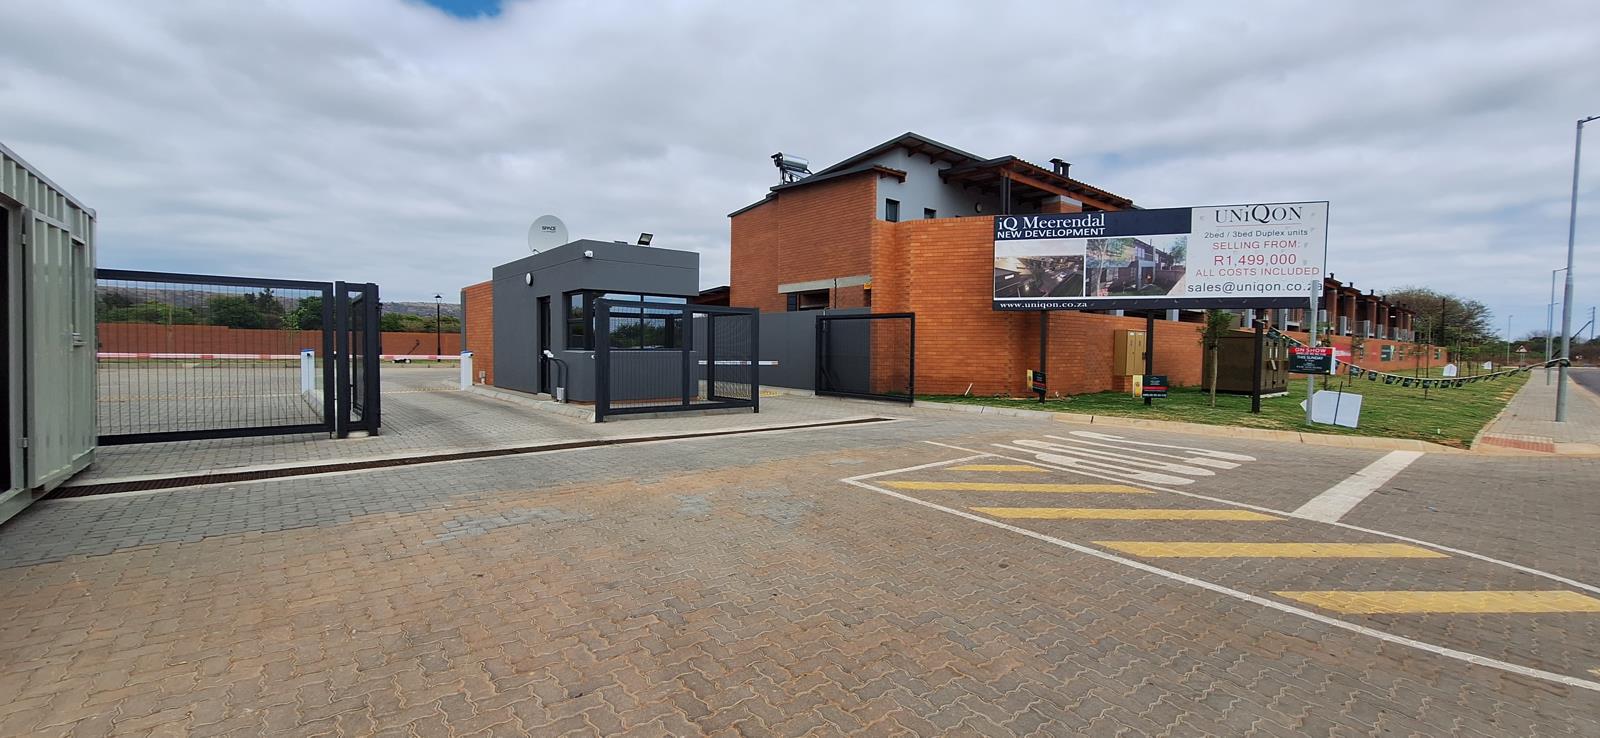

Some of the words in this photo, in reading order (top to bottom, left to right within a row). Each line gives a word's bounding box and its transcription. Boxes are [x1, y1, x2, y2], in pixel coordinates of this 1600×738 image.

[998, 217, 1018, 231] iQ
[1023, 213, 1105, 229] Meerendal
[997, 230, 1022, 239] NEW
[1025, 228, 1106, 238] DEVELOPMENT
[1233, 230, 1253, 238] 3bed
[1256, 229, 1285, 238] Duplex
[1213, 241, 1260, 250] SELLING
[1214, 254, 1297, 266] R1,499,000
[1196, 269, 1214, 277] ALL
[1218, 268, 1257, 276] COSTS
[1262, 267, 1320, 276] INCLUDED
[1000, 301, 1087, 309] www.uniqon.co.za
